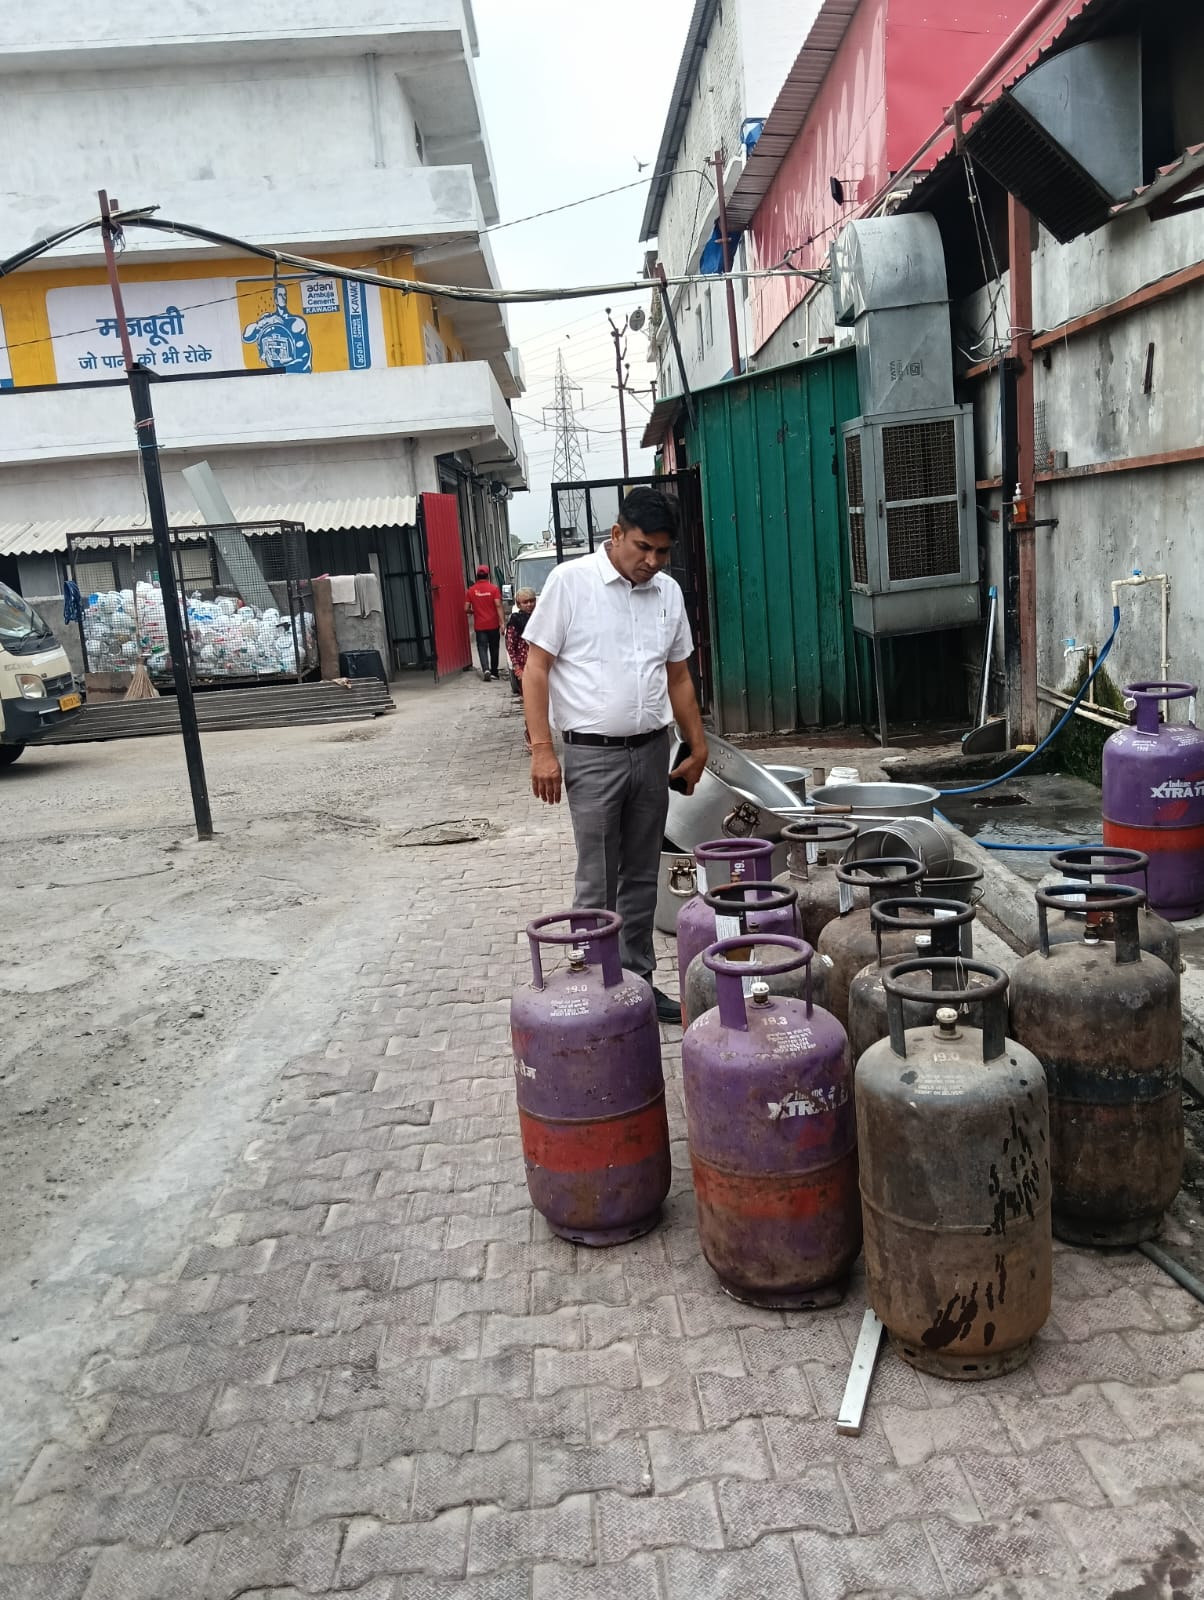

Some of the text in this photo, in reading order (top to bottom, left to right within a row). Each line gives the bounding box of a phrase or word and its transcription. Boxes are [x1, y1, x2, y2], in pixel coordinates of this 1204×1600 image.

[307, 281, 333, 292] adani
[307, 291, 335, 299] Ambuja
[350, 281, 360, 314] KAWAC
[307, 298, 336, 306] Cement
[78, 344, 213, 369] जो पान को भी रोके
[355, 342, 364, 363] adani
[933, 1052, 960, 1063] 19.0
